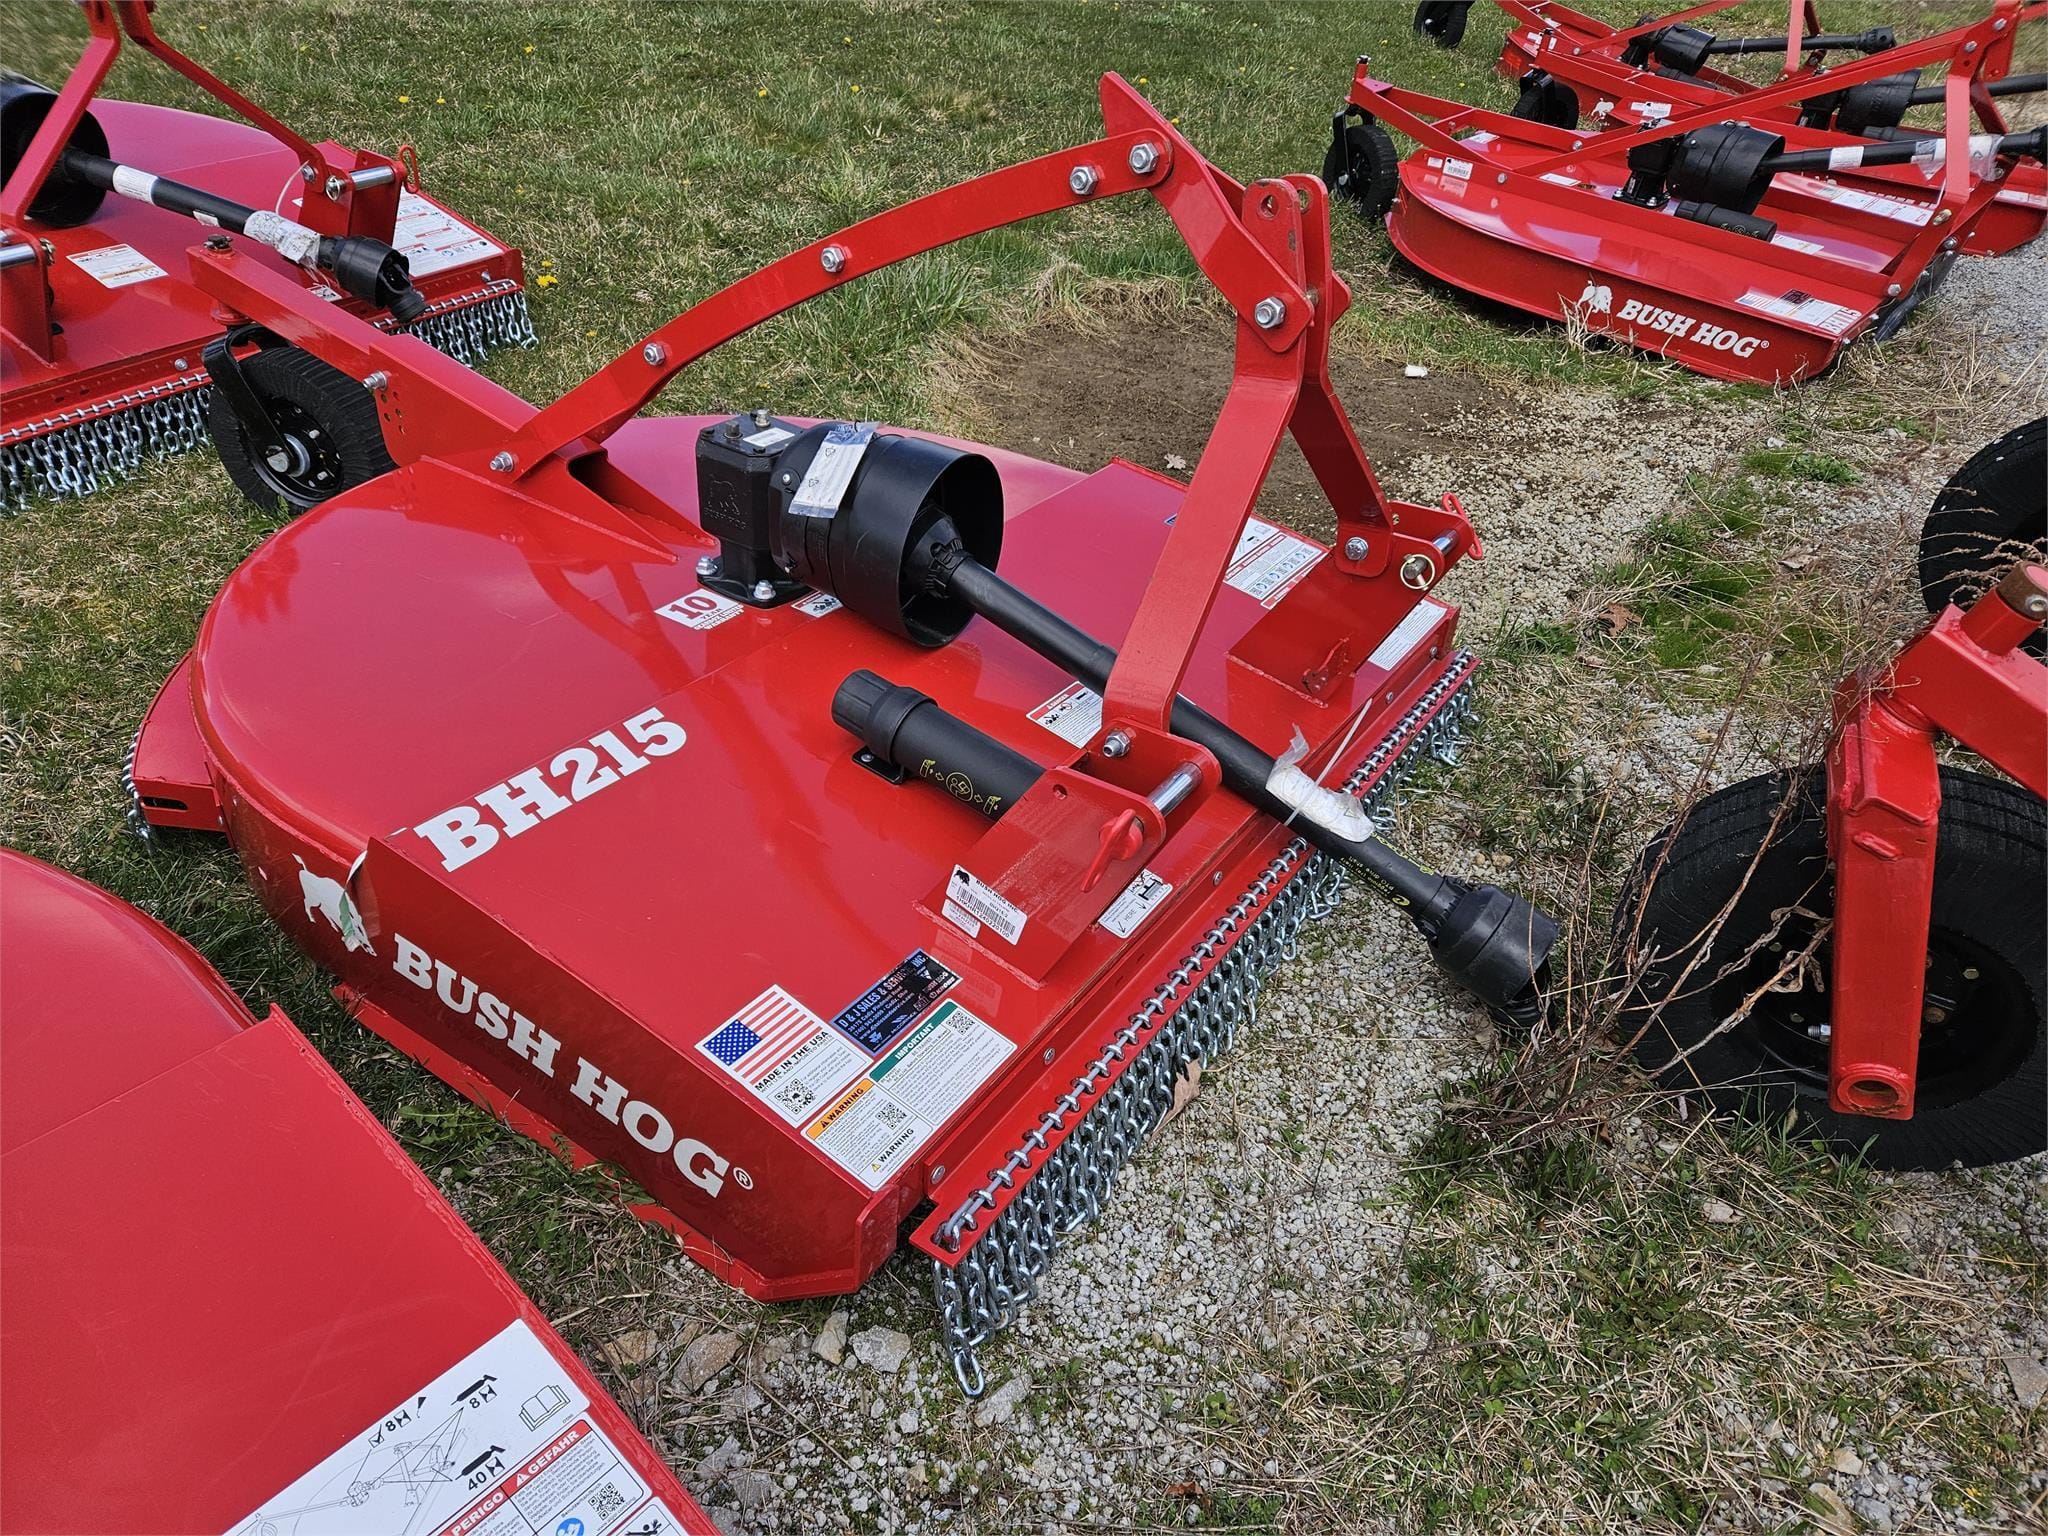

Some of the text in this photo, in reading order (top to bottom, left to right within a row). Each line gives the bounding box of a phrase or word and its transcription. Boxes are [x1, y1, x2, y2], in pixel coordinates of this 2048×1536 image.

[1616, 299, 1697, 338] BUSH
[667, 594, 718, 621] 10
[412, 706, 688, 873] BH215
[392, 932, 561, 1079] BUSH
[838, 1018, 849, 1027] D
[844, 1012, 856, 1021] &
[856, 991, 881, 1013] SALES
[876, 986, 887, 995] &
[753, 1029, 829, 1091] MADE IN THE USA
[894, 1022, 935, 1060] IMPORTANT
[826, 1086, 865, 1122] WARNING
[877, 1127, 915, 1163] WARNING
[469, 1397, 481, 1409] 8
[385, 1420, 396, 1432] 8
[525, 1429, 580, 1475] GEFAHR
[467, 1471, 487, 1491] 40
[449, 1490, 506, 1536] PERIGO
